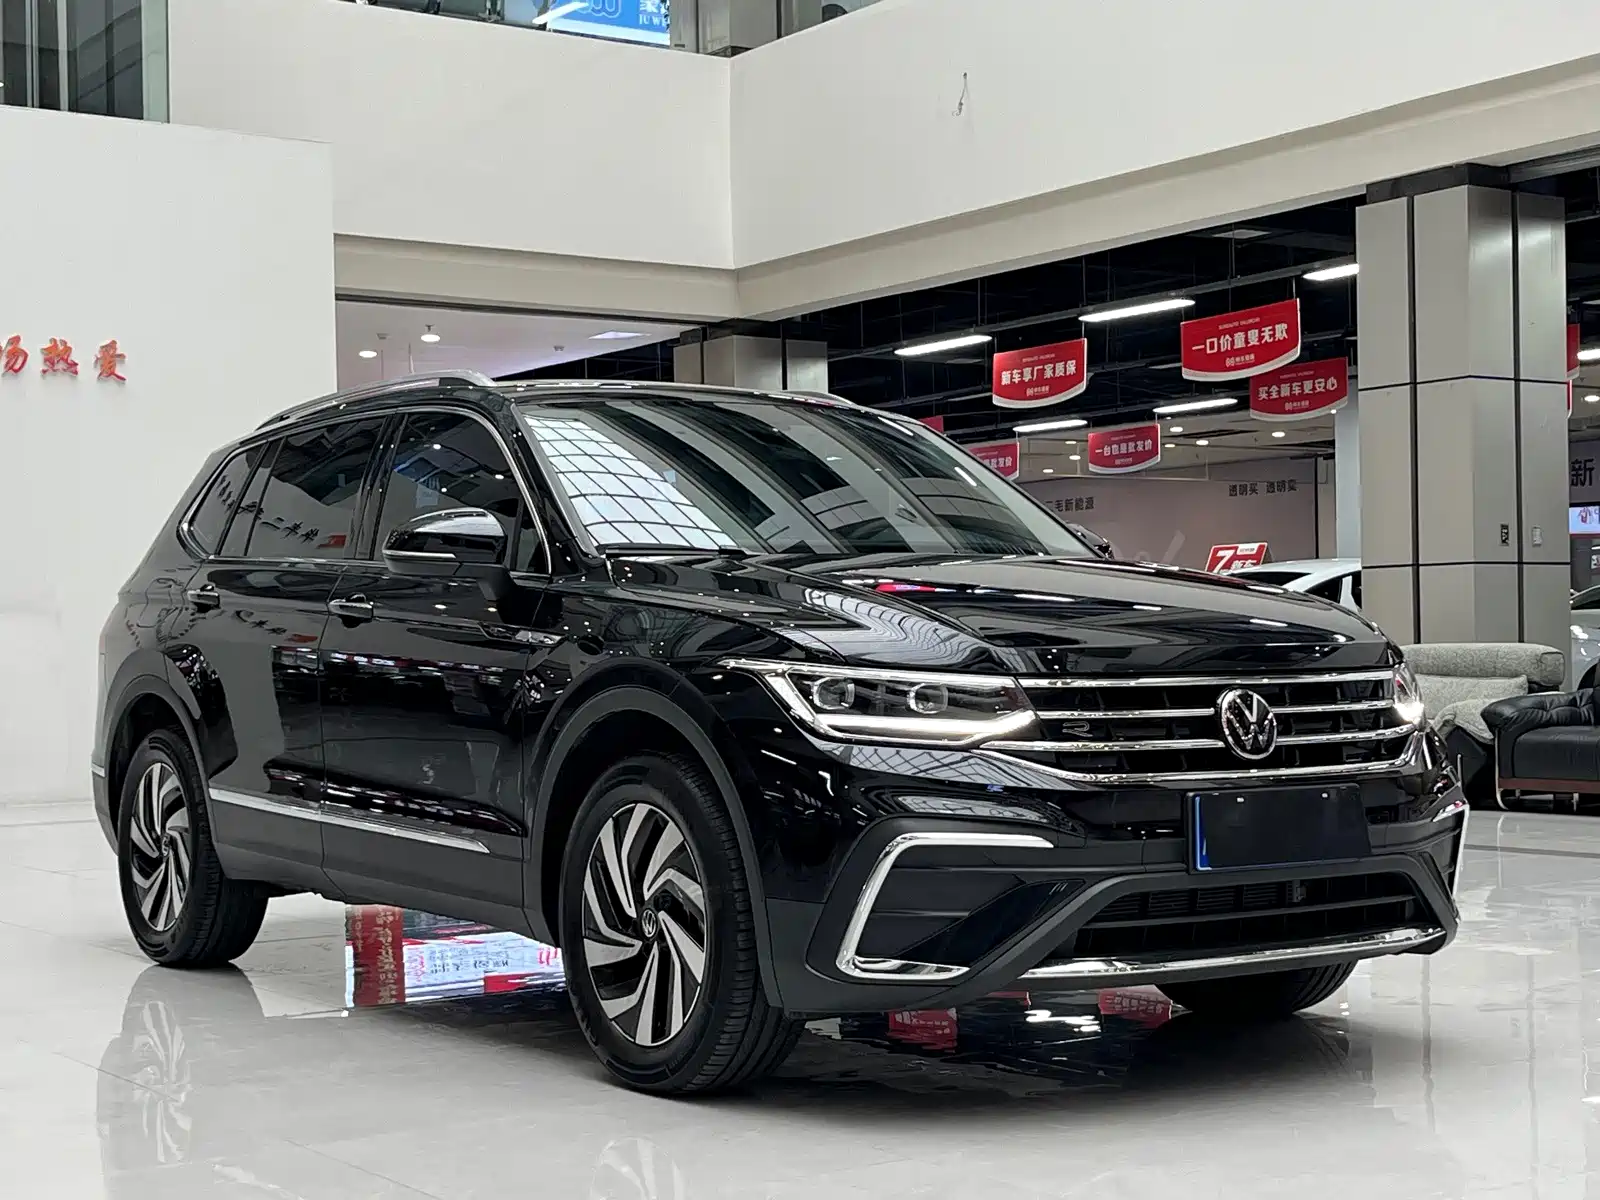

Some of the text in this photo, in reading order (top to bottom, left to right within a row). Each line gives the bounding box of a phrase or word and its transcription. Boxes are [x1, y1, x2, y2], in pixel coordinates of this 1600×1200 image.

[1001, 360, 1077, 386] 新车享厂家质保
[1258, 376, 1339, 401] 买全新车更安心
[1571, 458, 1594, 487] 新
